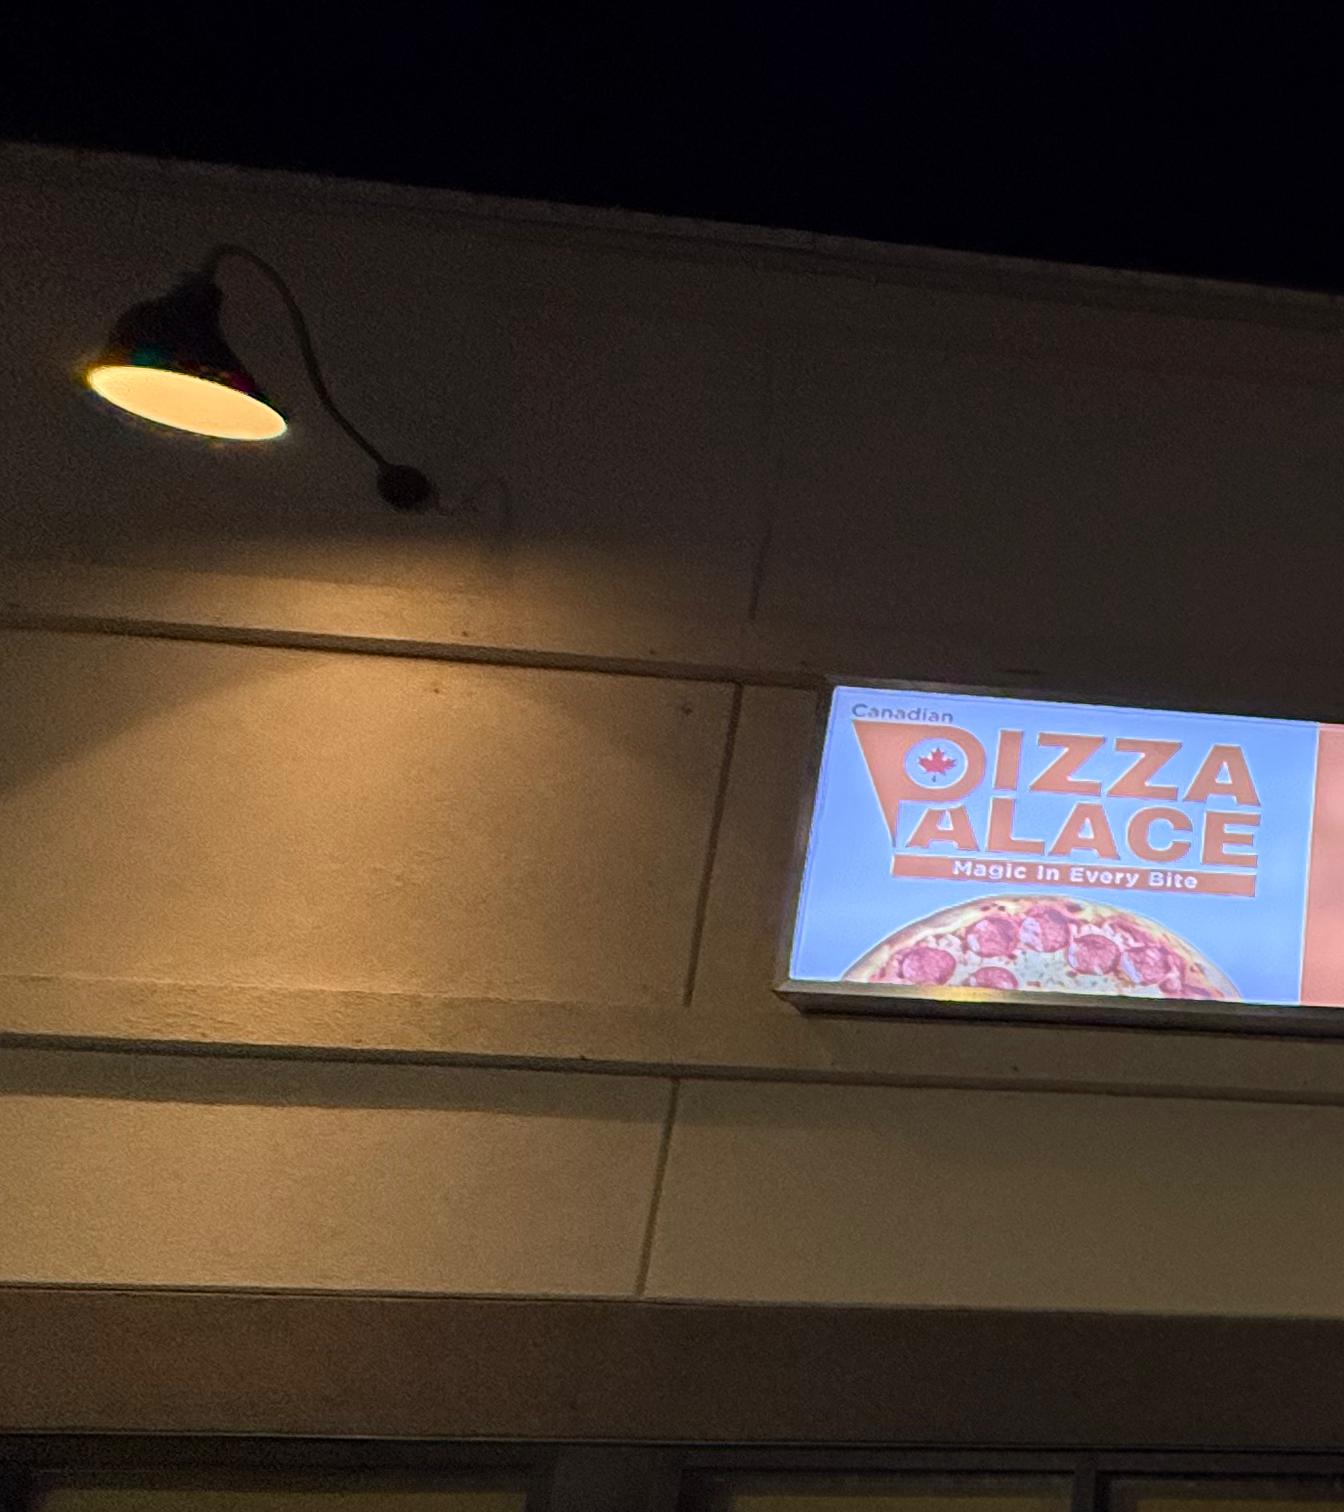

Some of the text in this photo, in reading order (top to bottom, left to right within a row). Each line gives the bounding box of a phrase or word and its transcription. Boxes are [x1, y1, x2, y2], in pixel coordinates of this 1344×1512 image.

[851, 703, 954, 724] Canadian
[851, 720, 1261, 808] PIZZA
[952, 860, 1198, 890] Magic In Every Bite
